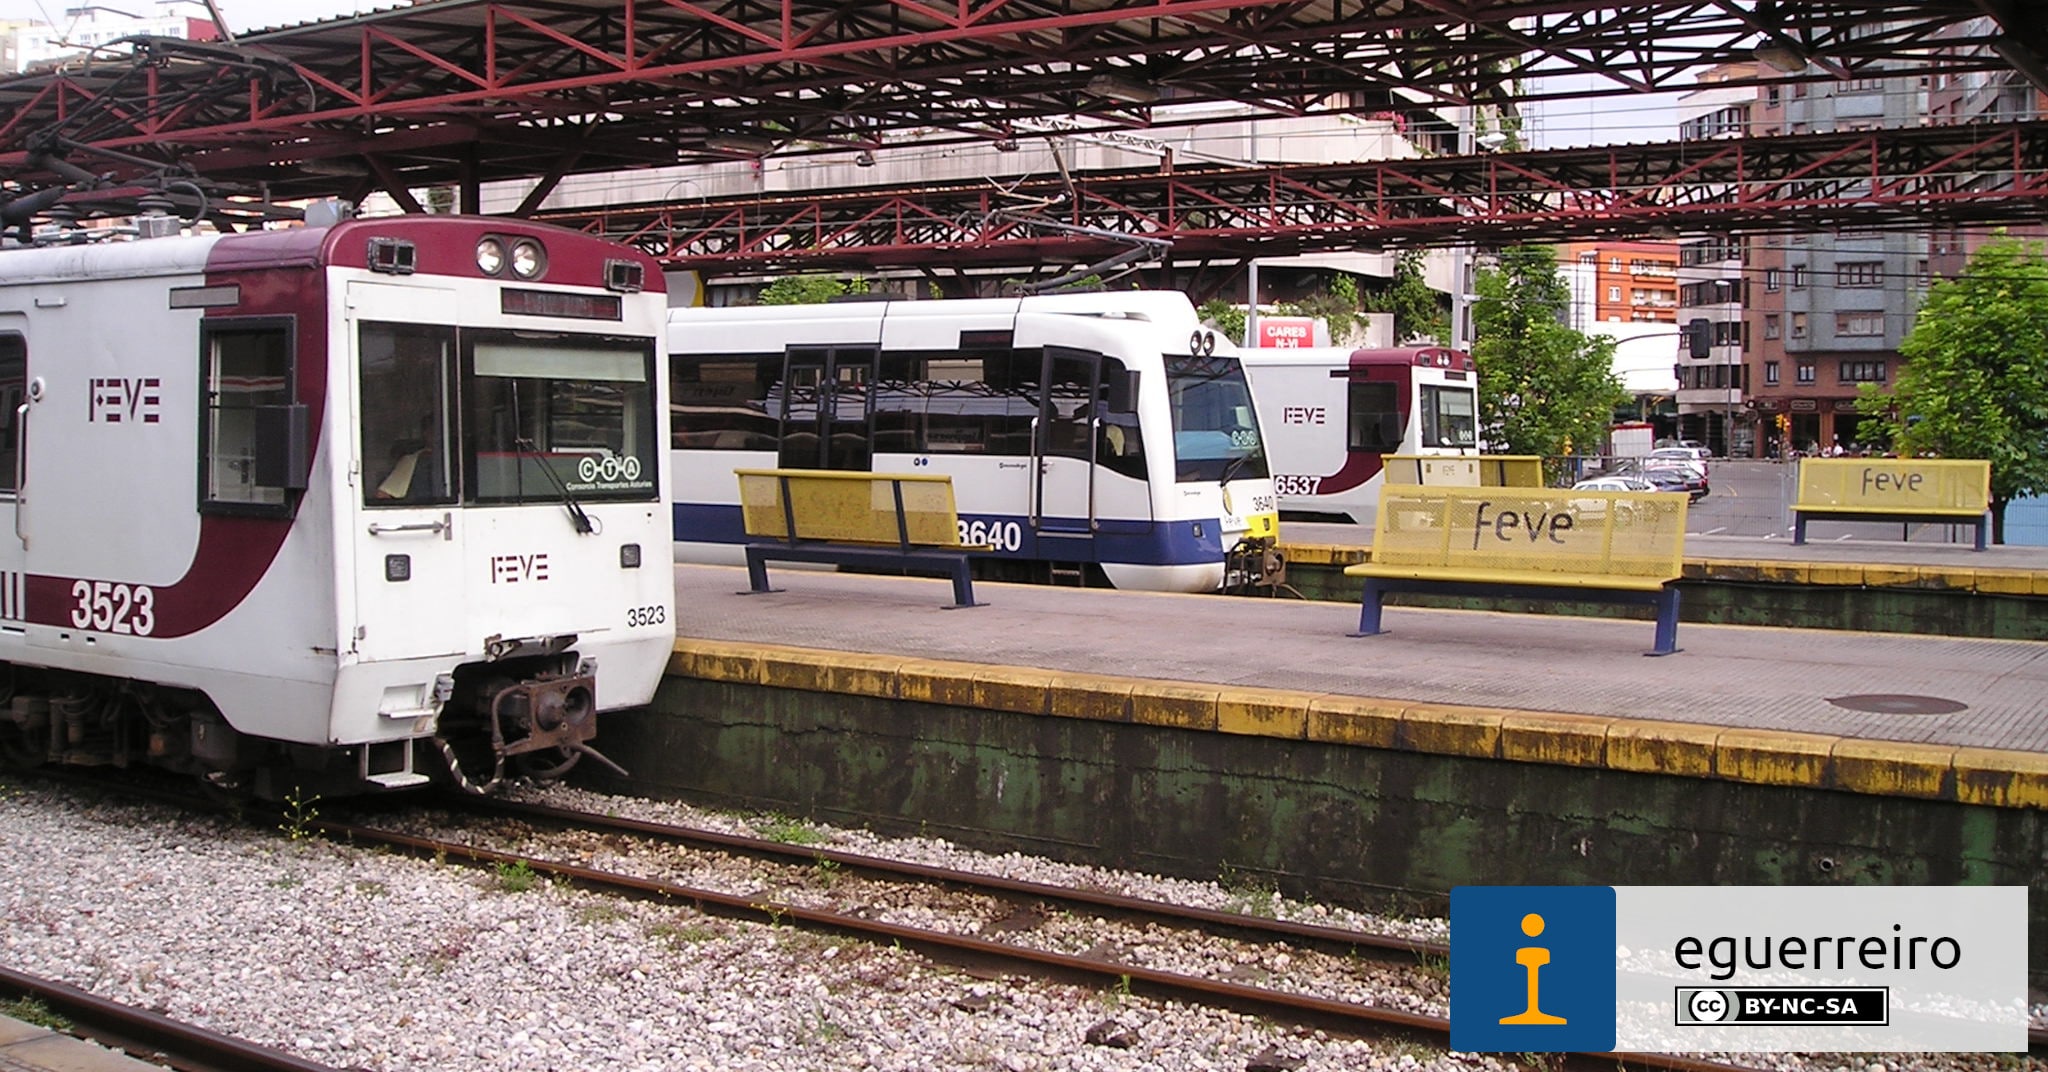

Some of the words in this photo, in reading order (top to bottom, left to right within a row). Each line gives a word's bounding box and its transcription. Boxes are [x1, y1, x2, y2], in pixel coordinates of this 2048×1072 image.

[1266, 326, 1307, 338] CARES
[89, 378, 160, 422] FEVE
[1284, 407, 1325, 424] FEVE
[1275, 475, 1322, 495] 6537
[1862, 467, 1923, 496] feve
[957, 520, 1022, 552] 3640
[1473, 501, 1573, 550] feve
[491, 554, 549, 584] FEVE
[72, 580, 154, 636] 3523
[627, 605, 666, 628] 3523
